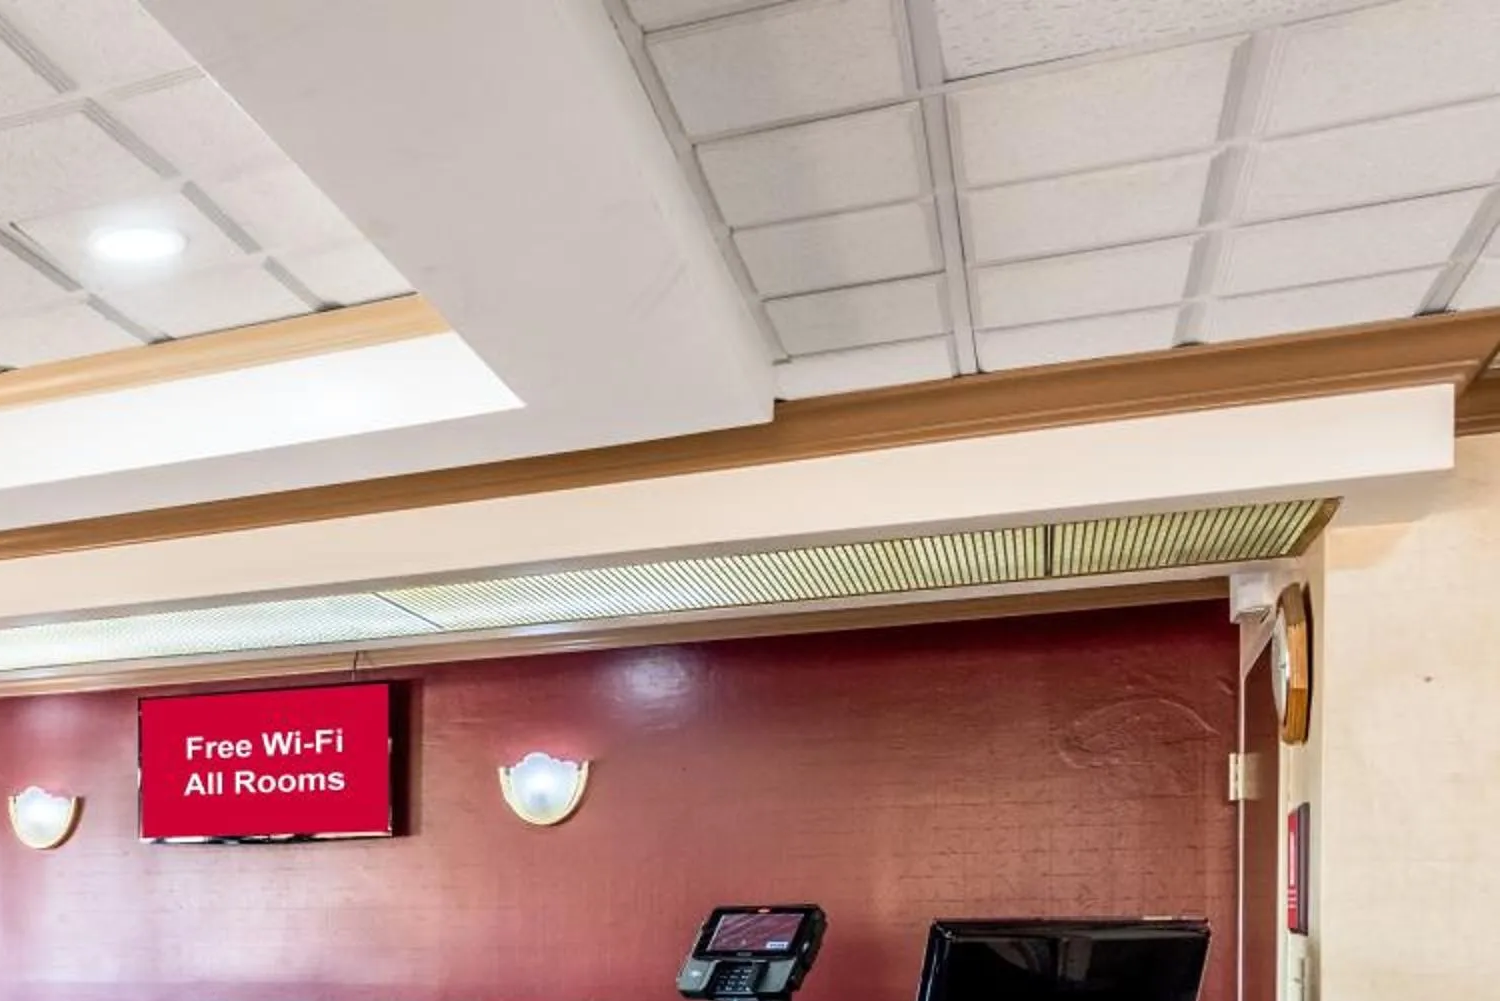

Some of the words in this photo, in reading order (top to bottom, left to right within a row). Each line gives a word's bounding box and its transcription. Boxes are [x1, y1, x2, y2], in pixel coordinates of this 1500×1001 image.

[186, 736, 252, 760] Free
[261, 728, 344, 757] Wi-Fi
[184, 772, 224, 796] All
[235, 770, 346, 794] Rooms
